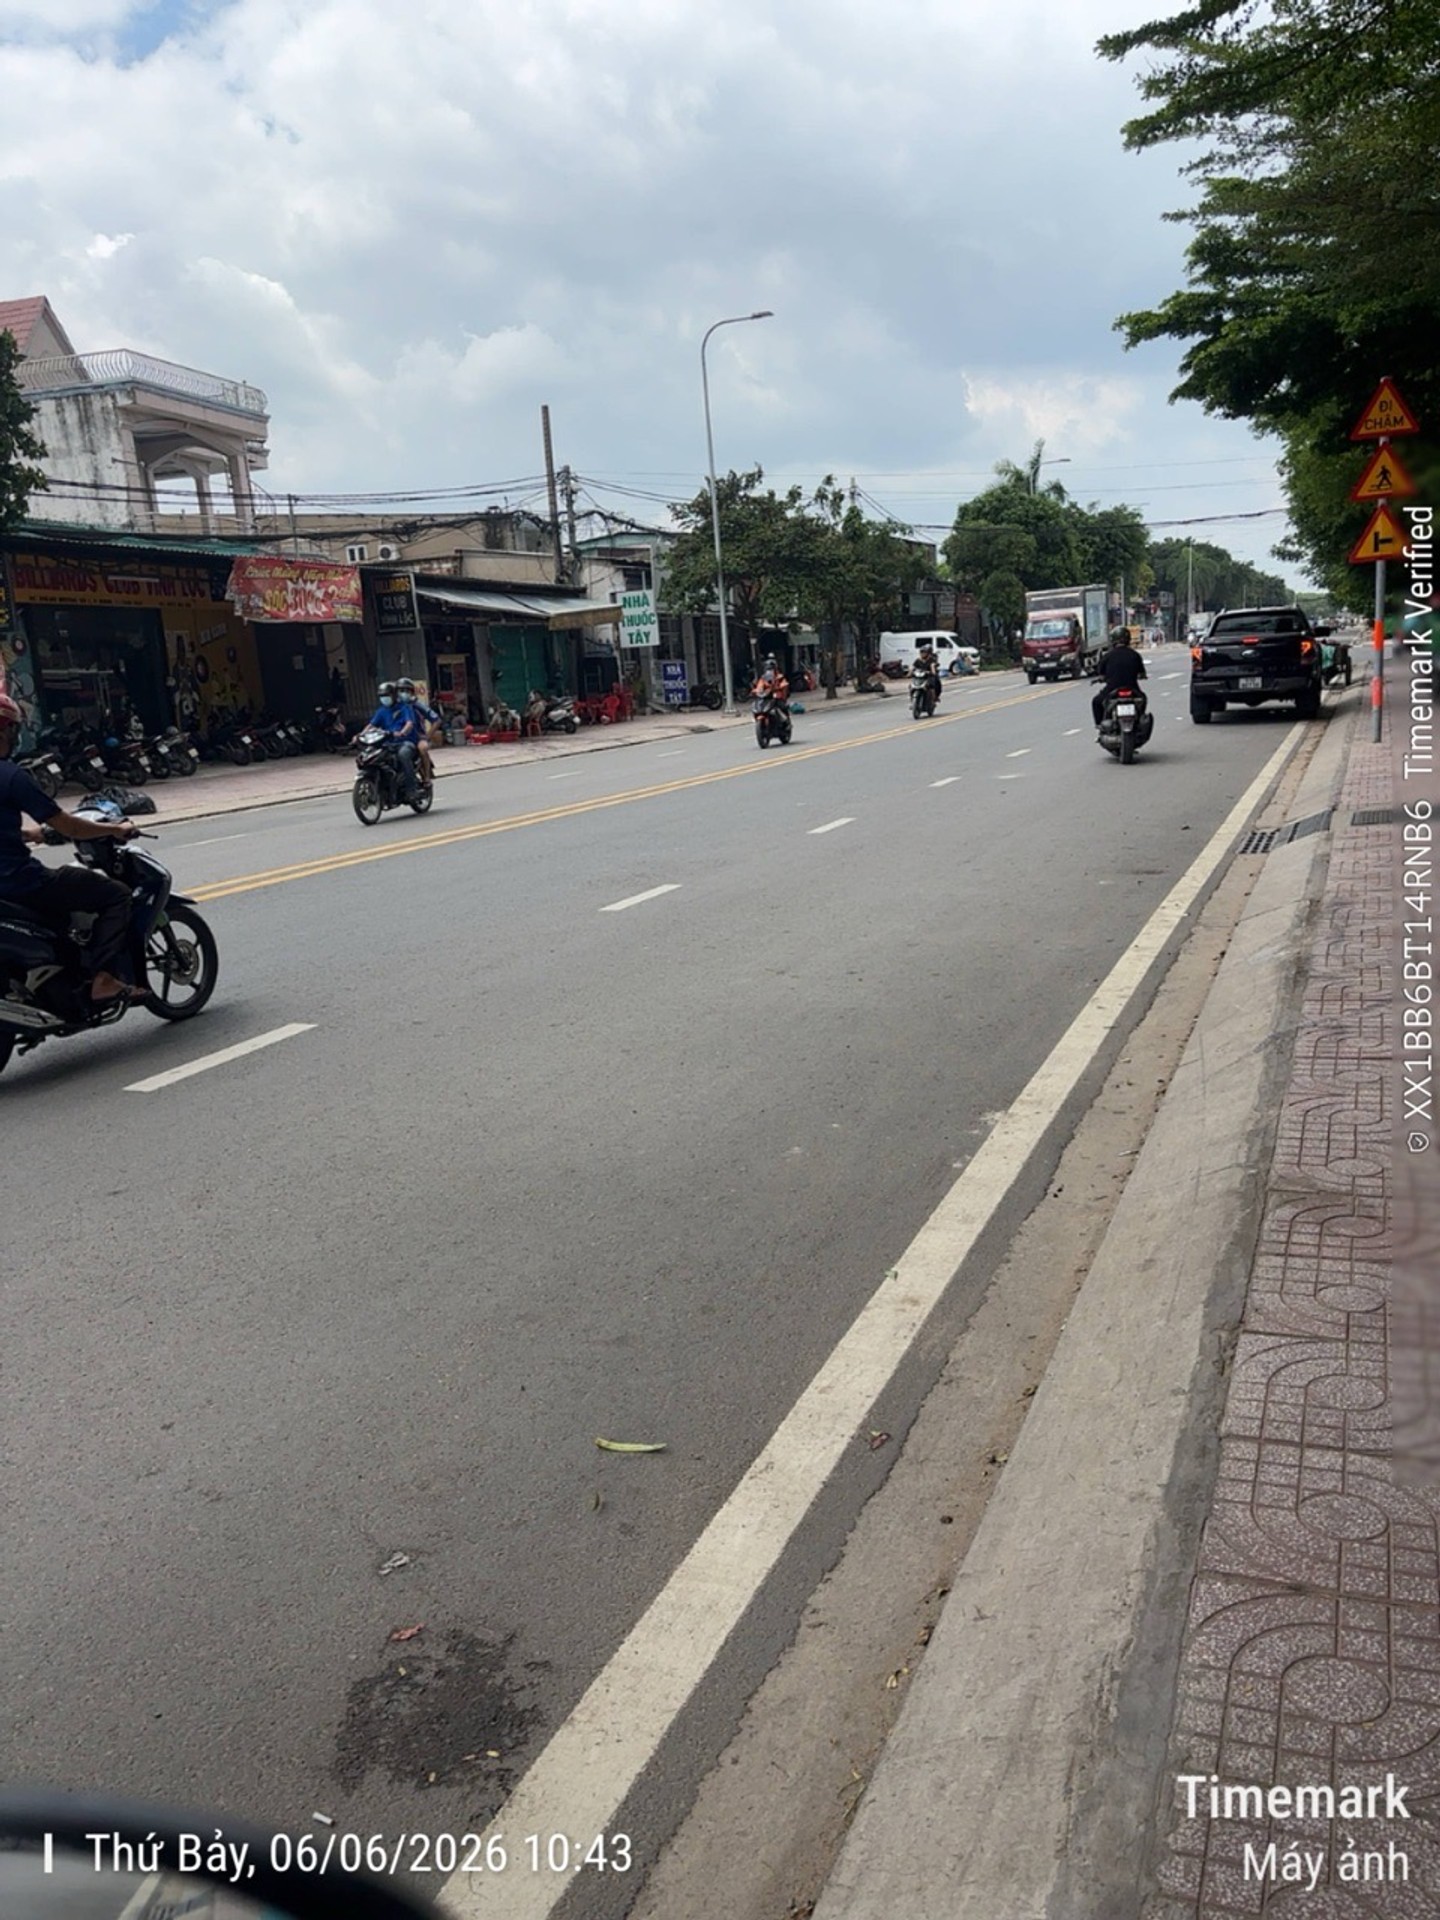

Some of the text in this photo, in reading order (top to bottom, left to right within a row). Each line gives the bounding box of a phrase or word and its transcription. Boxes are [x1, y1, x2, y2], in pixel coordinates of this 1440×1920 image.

[1378, 399, 1393, 413] ĐI
[382, 595, 408, 609] CLUB
[622, 592, 650, 608] NHÀ
[628, 629, 651, 645] TÂY
